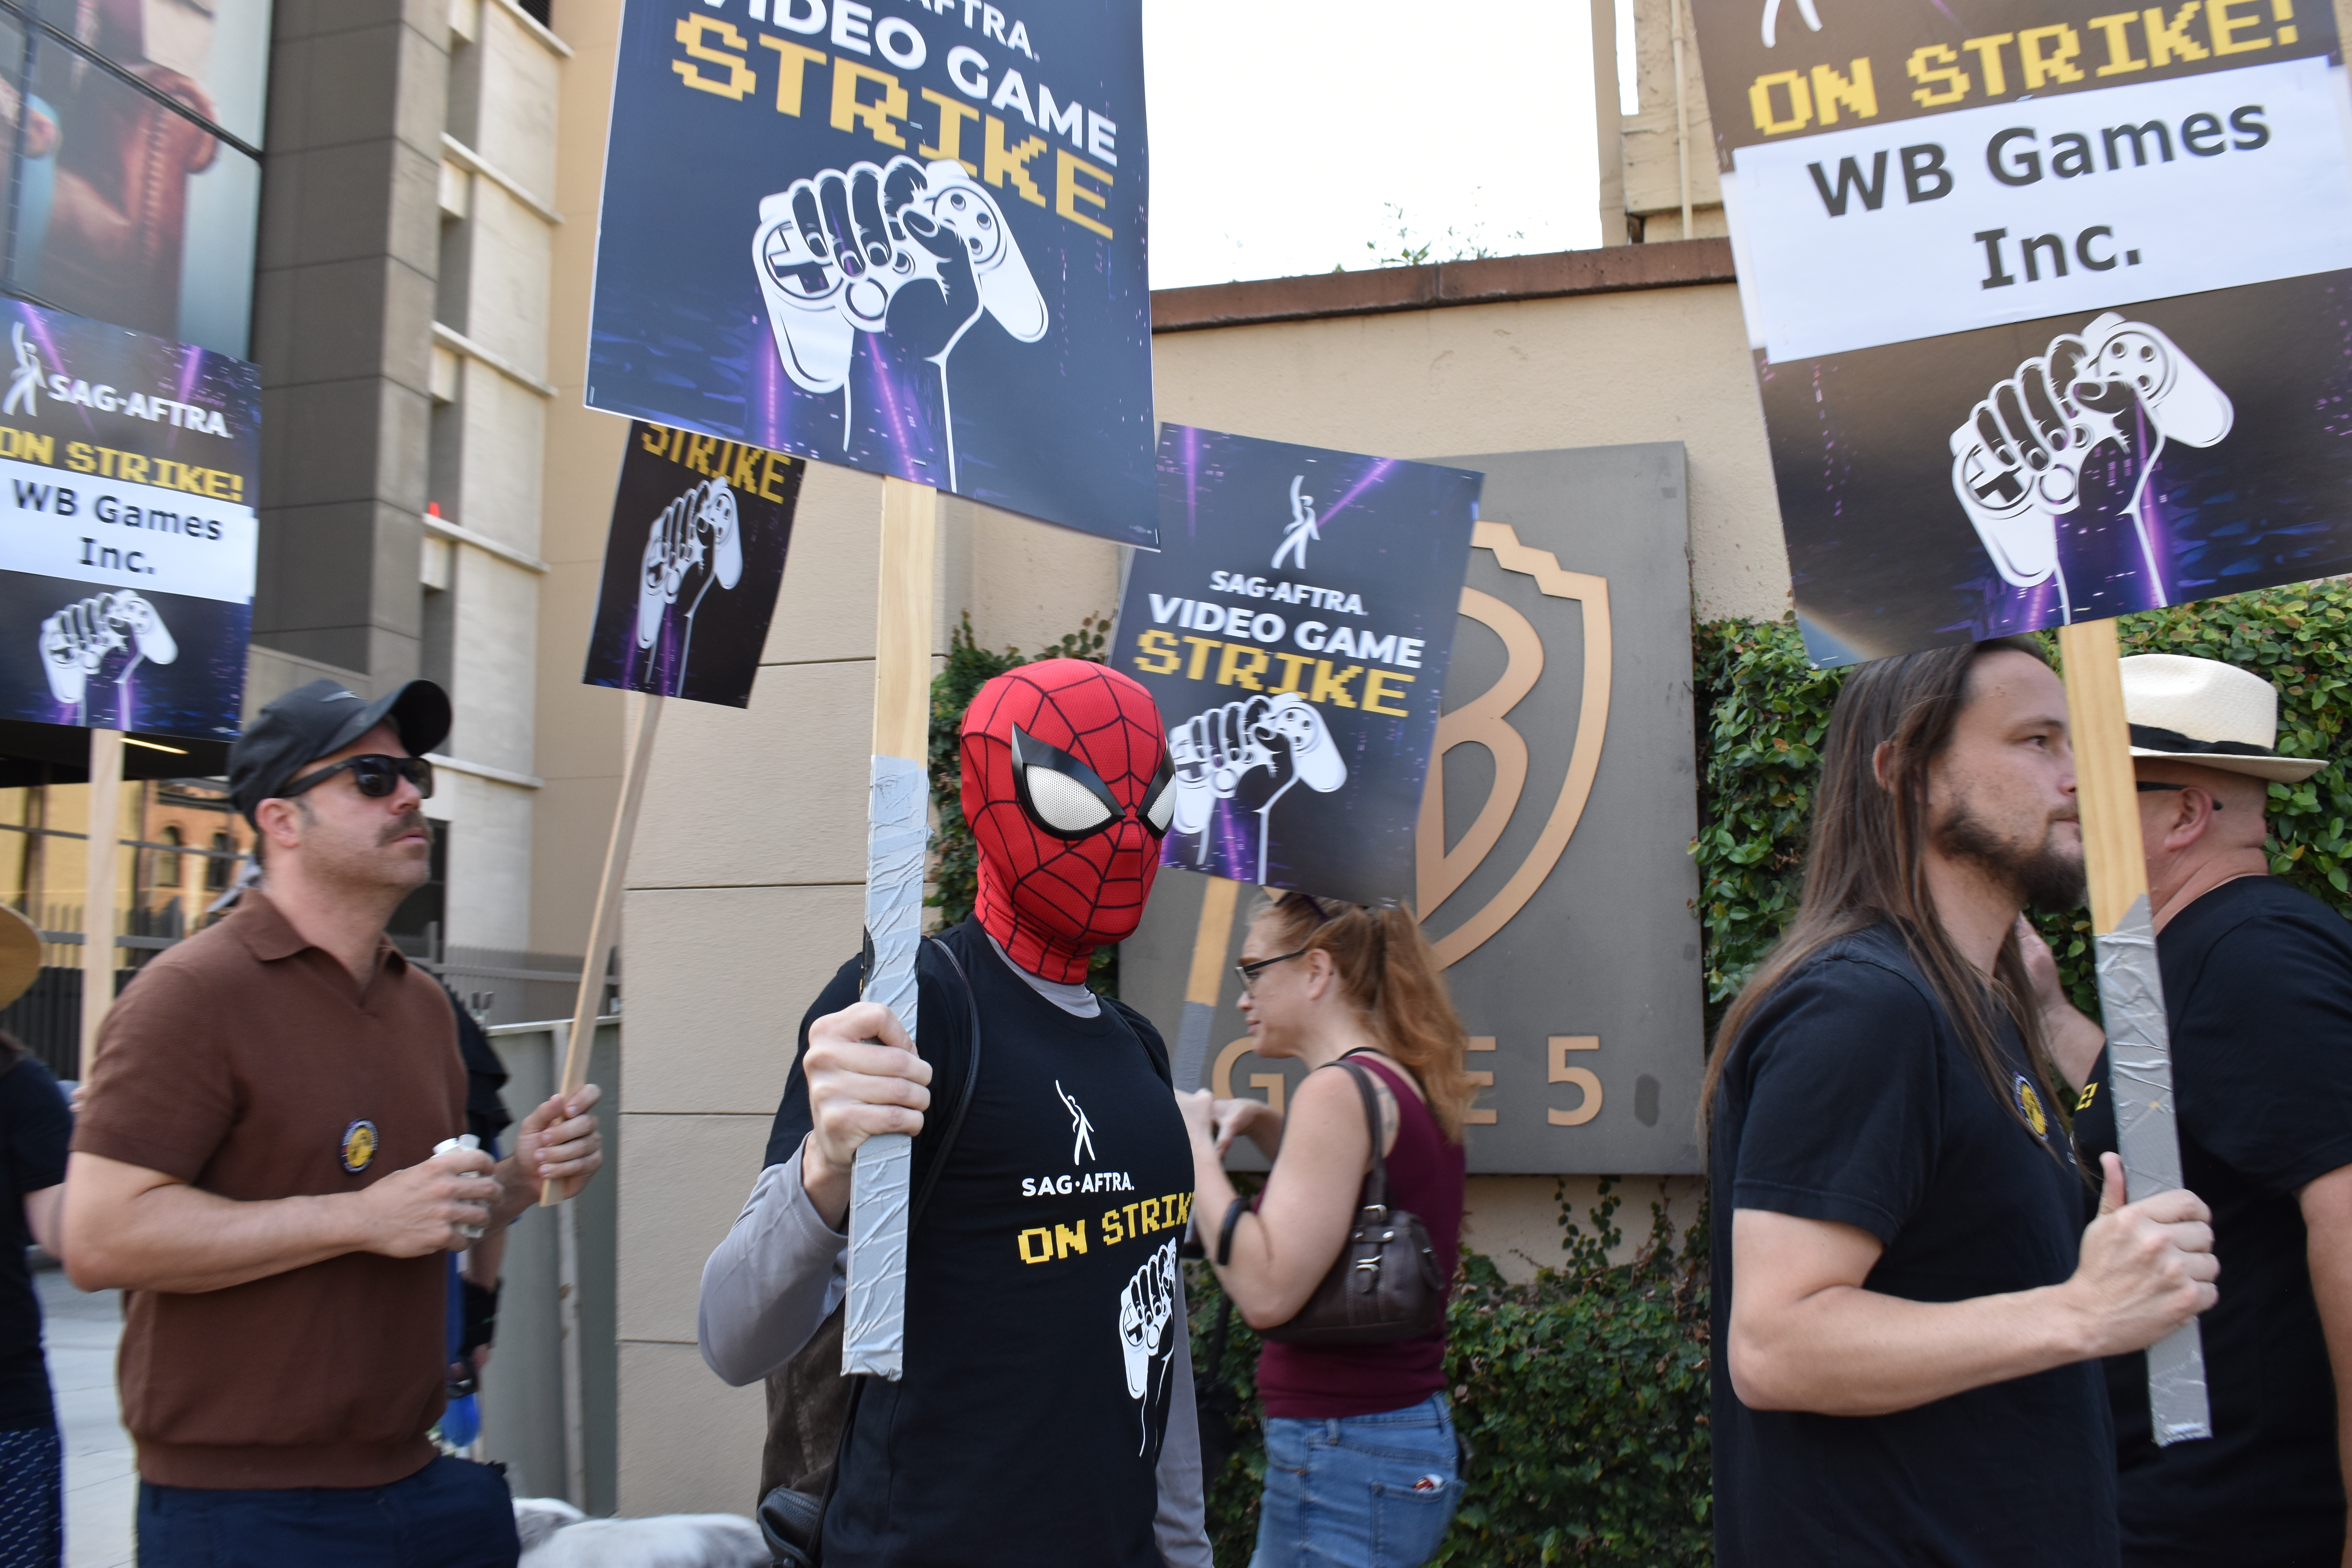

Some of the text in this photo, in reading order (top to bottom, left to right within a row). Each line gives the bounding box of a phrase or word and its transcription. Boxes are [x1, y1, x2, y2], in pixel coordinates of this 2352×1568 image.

[704, 0, 1117, 167] DEO GAME
[1748, 0, 2299, 136] ON STRIKE!
[672, 12, 1114, 240] STRIKE
[1806, 104, 2272, 218] WB Games
[1975, 224, 2142, 291] Inc.
[0, 426, 243, 502] ON STRIKE!
[641, 423, 791, 505] STRIKE
[11, 478, 223, 541] WB Games
[78, 536, 156, 575] Inc.
[1148, 593, 1426, 669] VIDEO GAME
[1133, 629, 1416, 718] STRIKE
[1548, 1035, 1603, 1126] 5
[1018, 1192, 1194, 1264] ON STRIK
